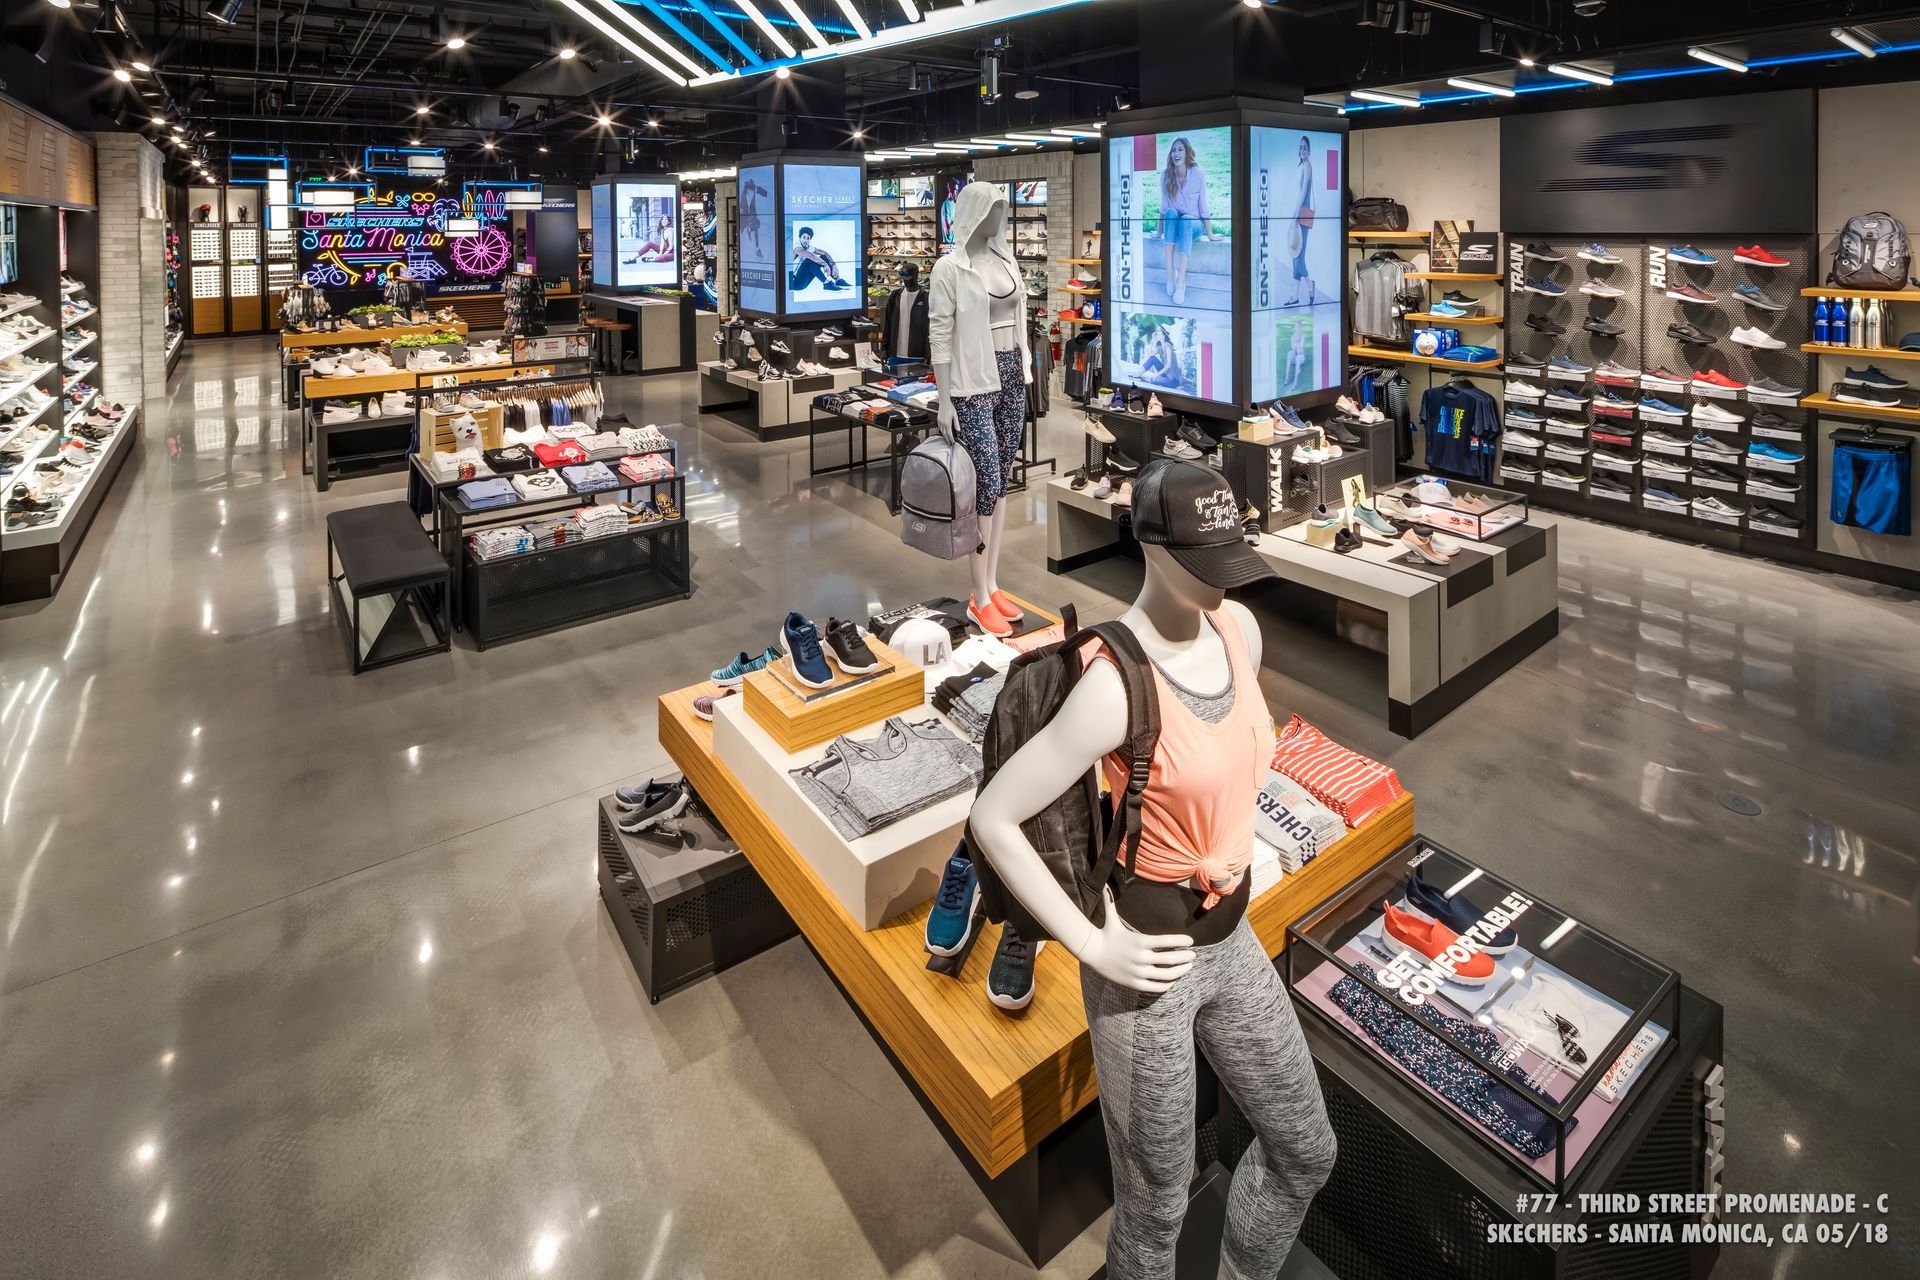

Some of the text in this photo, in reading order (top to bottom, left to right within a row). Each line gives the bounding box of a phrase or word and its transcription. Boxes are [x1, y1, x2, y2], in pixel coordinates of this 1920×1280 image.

[791, 195, 833, 204] SKECHER
[302, 227, 444, 251] Santa Monica
[1510, 243, 1524, 292] TRAIN
[1649, 246, 1667, 289] RUN
[439, 284, 492, 293] SKECHERS
[1270, 448, 1283, 512] WALK
[1195, 490, 1218, 514] good
[922, 641, 948, 667] LA
[1399, 890, 1534, 1006] COMFORTABLE!
[1377, 949, 1423, 990] GET
[1610, 1034, 1654, 1094] SKECHERS
